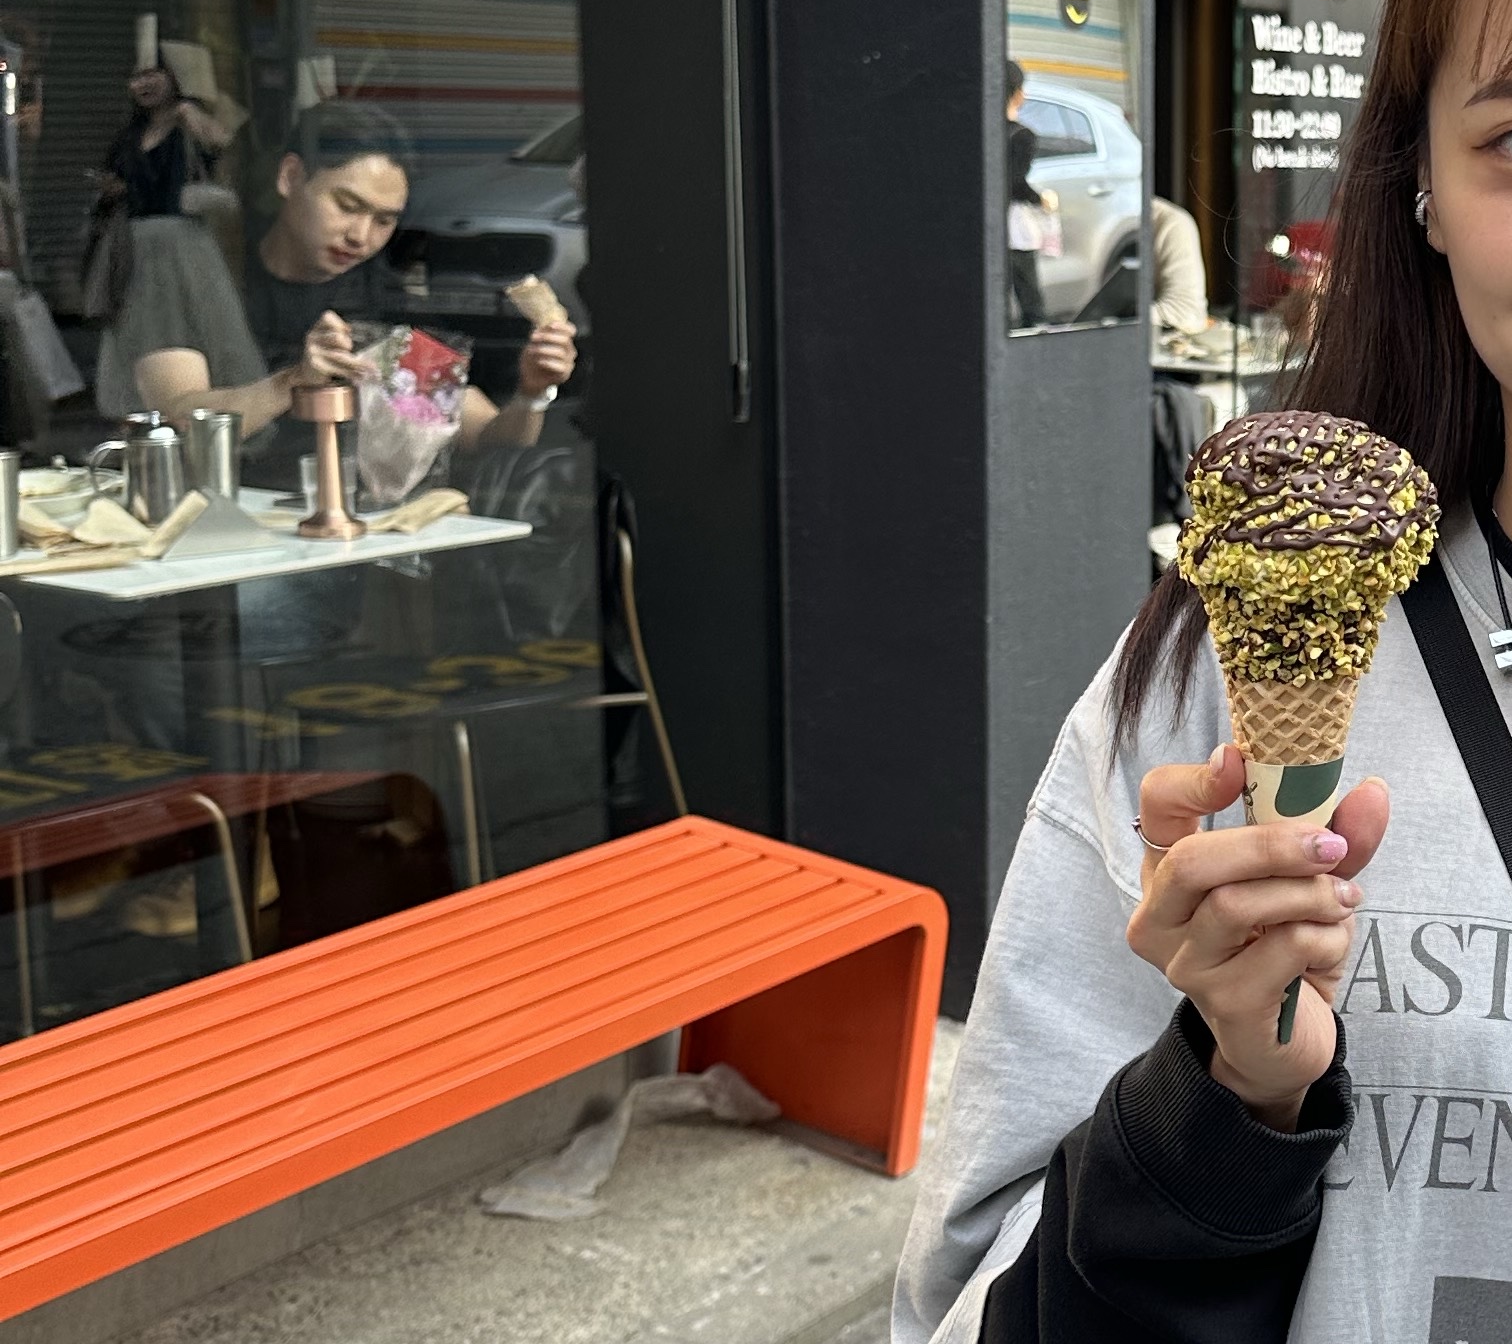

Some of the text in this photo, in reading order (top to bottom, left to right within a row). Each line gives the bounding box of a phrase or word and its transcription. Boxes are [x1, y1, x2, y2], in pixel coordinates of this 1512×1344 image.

[1251, 13, 1366, 58] Wine & Beer
[1311, 63, 1329, 97] &
[1329, 63, 1364, 99] Bar
